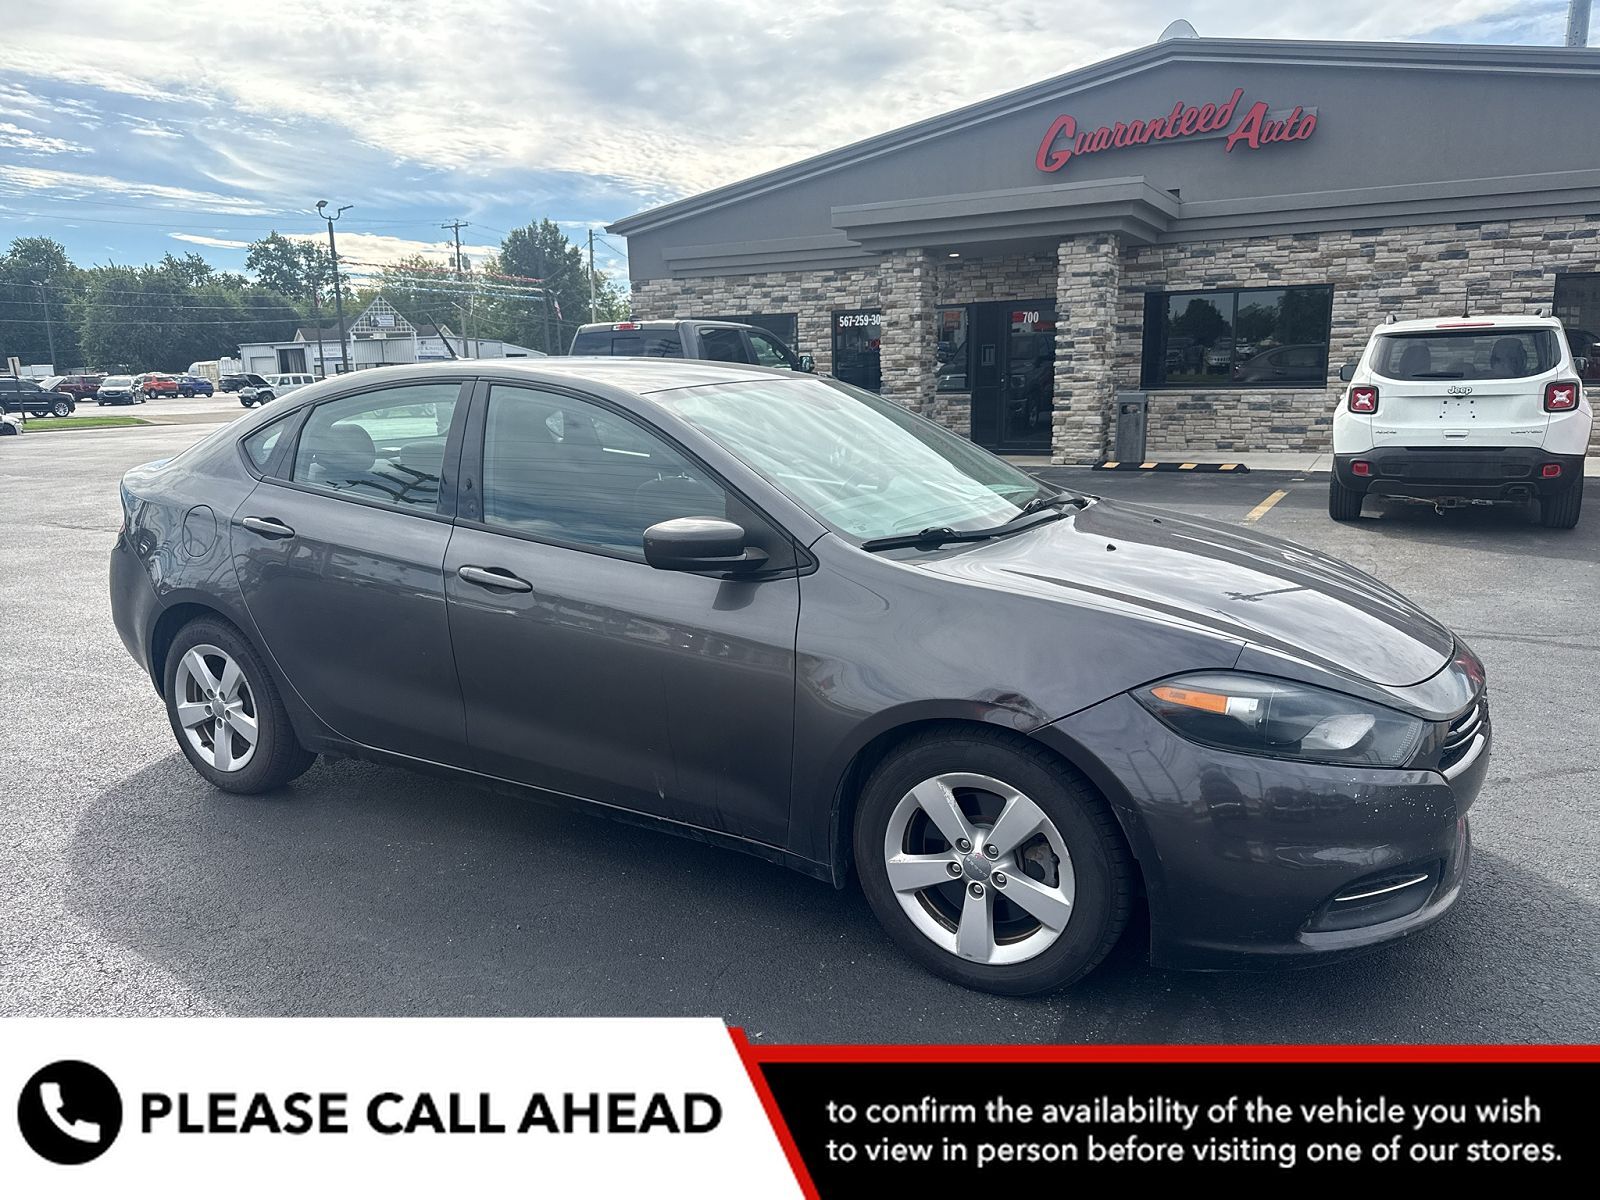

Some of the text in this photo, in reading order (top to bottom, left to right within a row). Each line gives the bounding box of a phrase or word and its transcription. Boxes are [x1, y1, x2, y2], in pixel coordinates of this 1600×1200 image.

[1035, 88, 1318, 172] Guaranteed Auto
[1022, 311, 1039, 323] 700
[1447, 385, 1472, 395] Jeep
